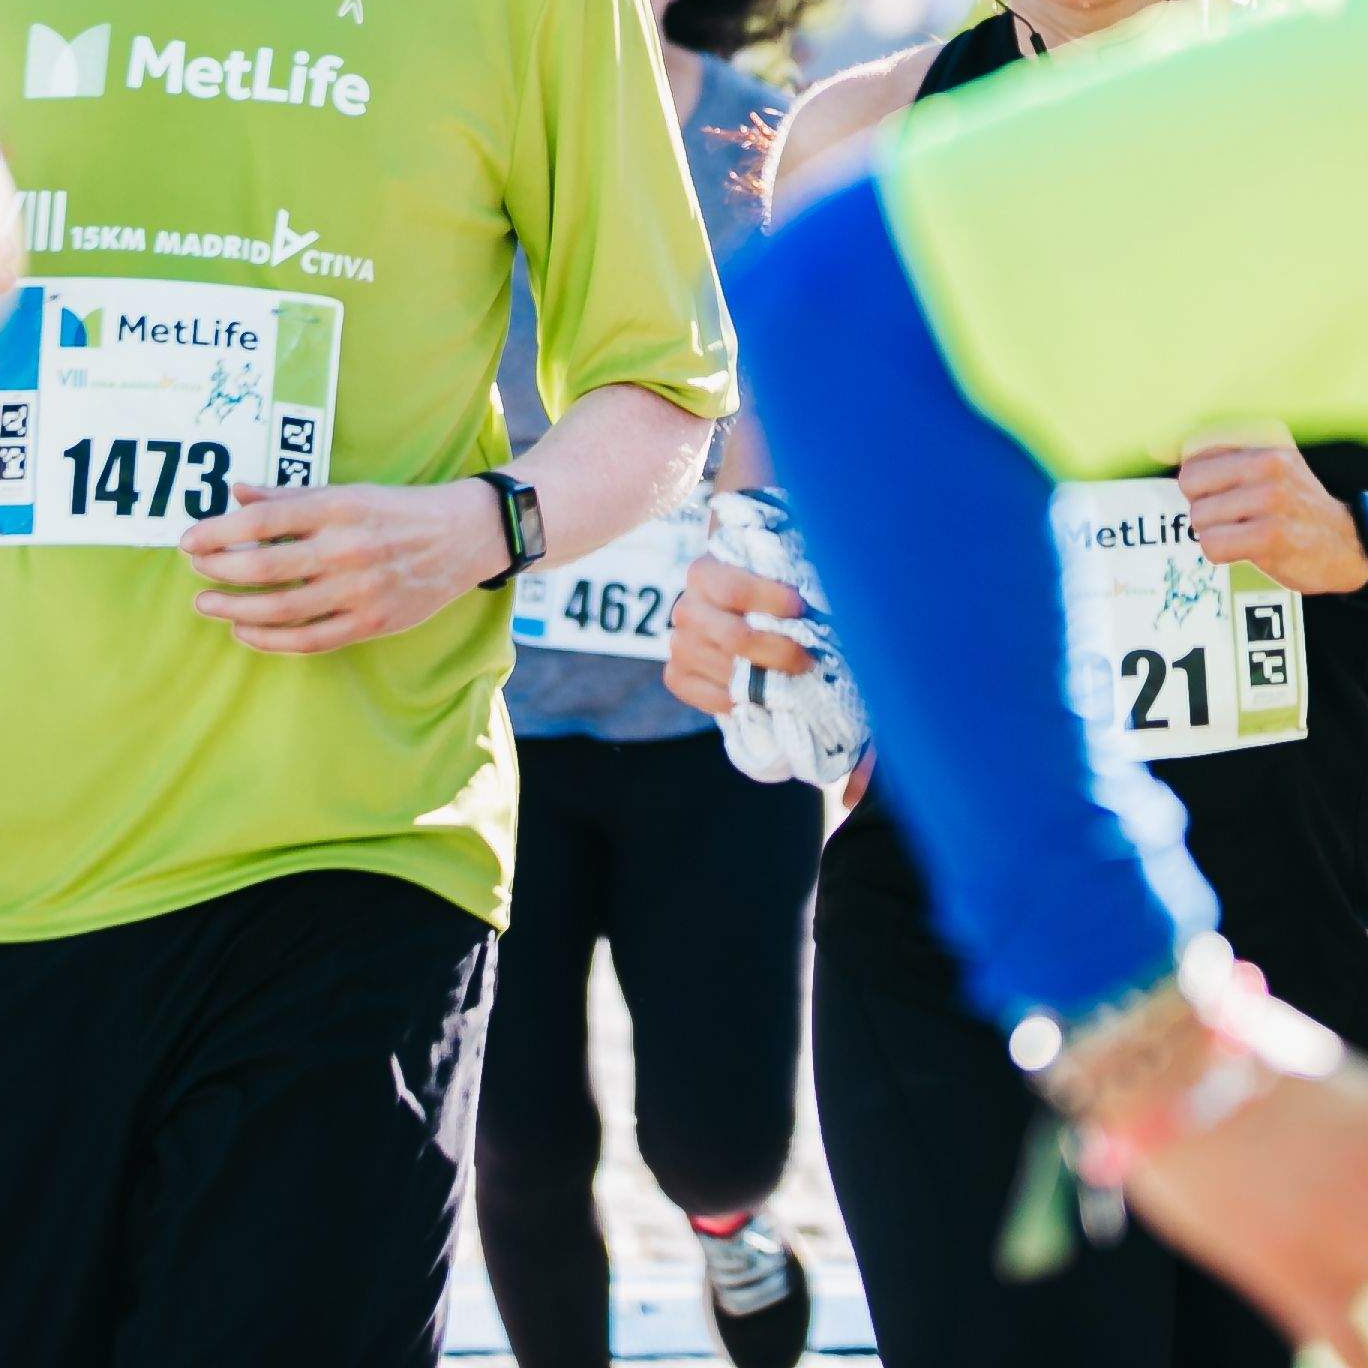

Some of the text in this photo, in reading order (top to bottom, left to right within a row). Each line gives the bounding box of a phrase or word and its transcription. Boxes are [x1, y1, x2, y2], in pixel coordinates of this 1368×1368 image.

[125, 34, 371, 117] MetLife
[71, 225, 146, 253] 15KM
[117, 314, 259, 351] MetLife
[64, 437, 232, 520] 1473
[1084, 646, 1211, 730] 21
